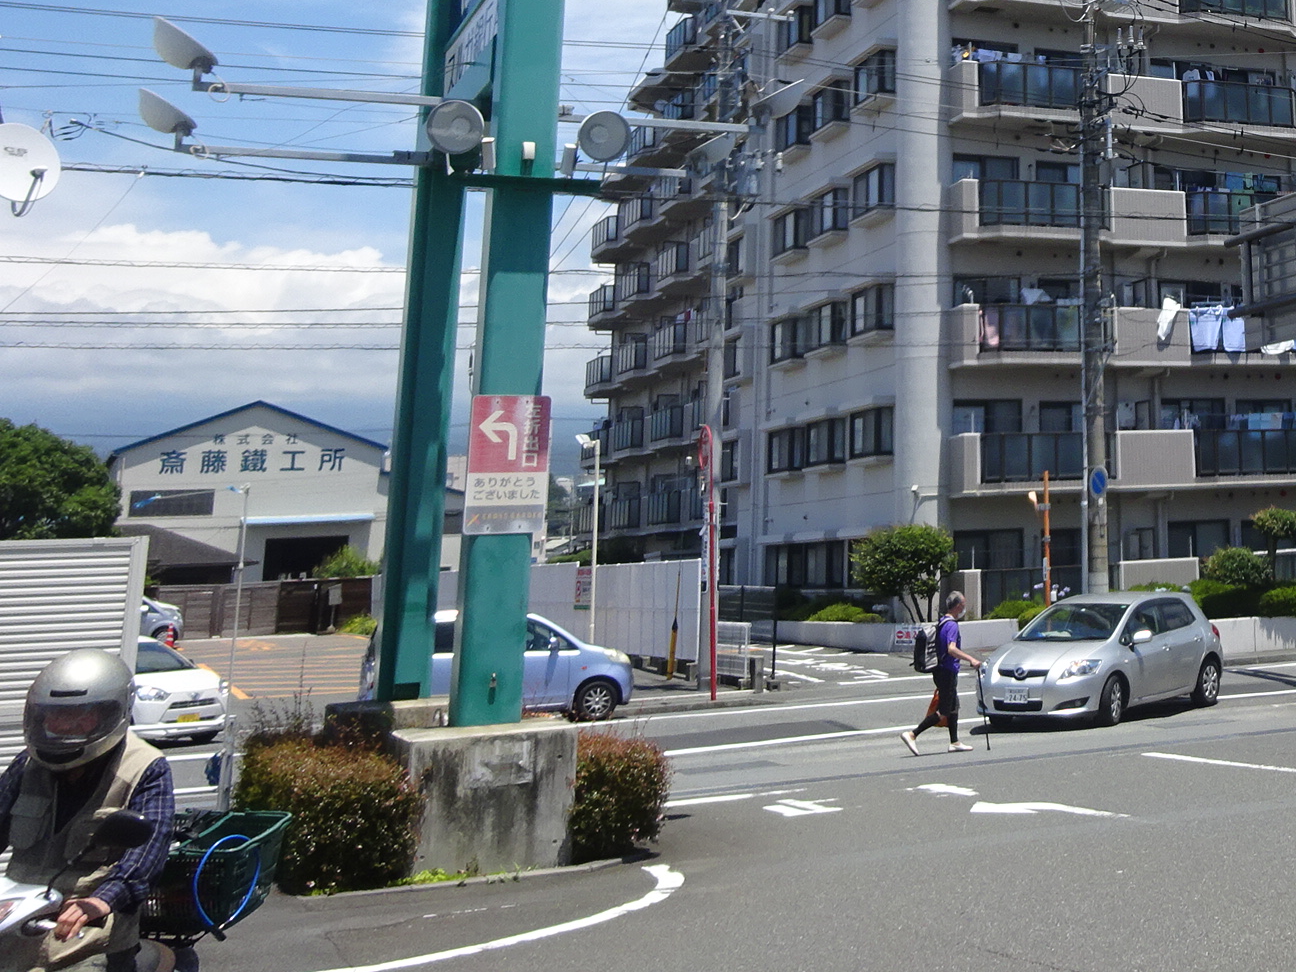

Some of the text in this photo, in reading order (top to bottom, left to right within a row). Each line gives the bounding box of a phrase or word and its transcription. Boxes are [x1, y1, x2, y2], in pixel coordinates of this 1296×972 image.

[213, 432, 299, 446] 株式会社
[521, 403, 542, 468] 左折出口
[474, 476, 537, 489] ありがとう
[472, 488, 542, 501] ございました
